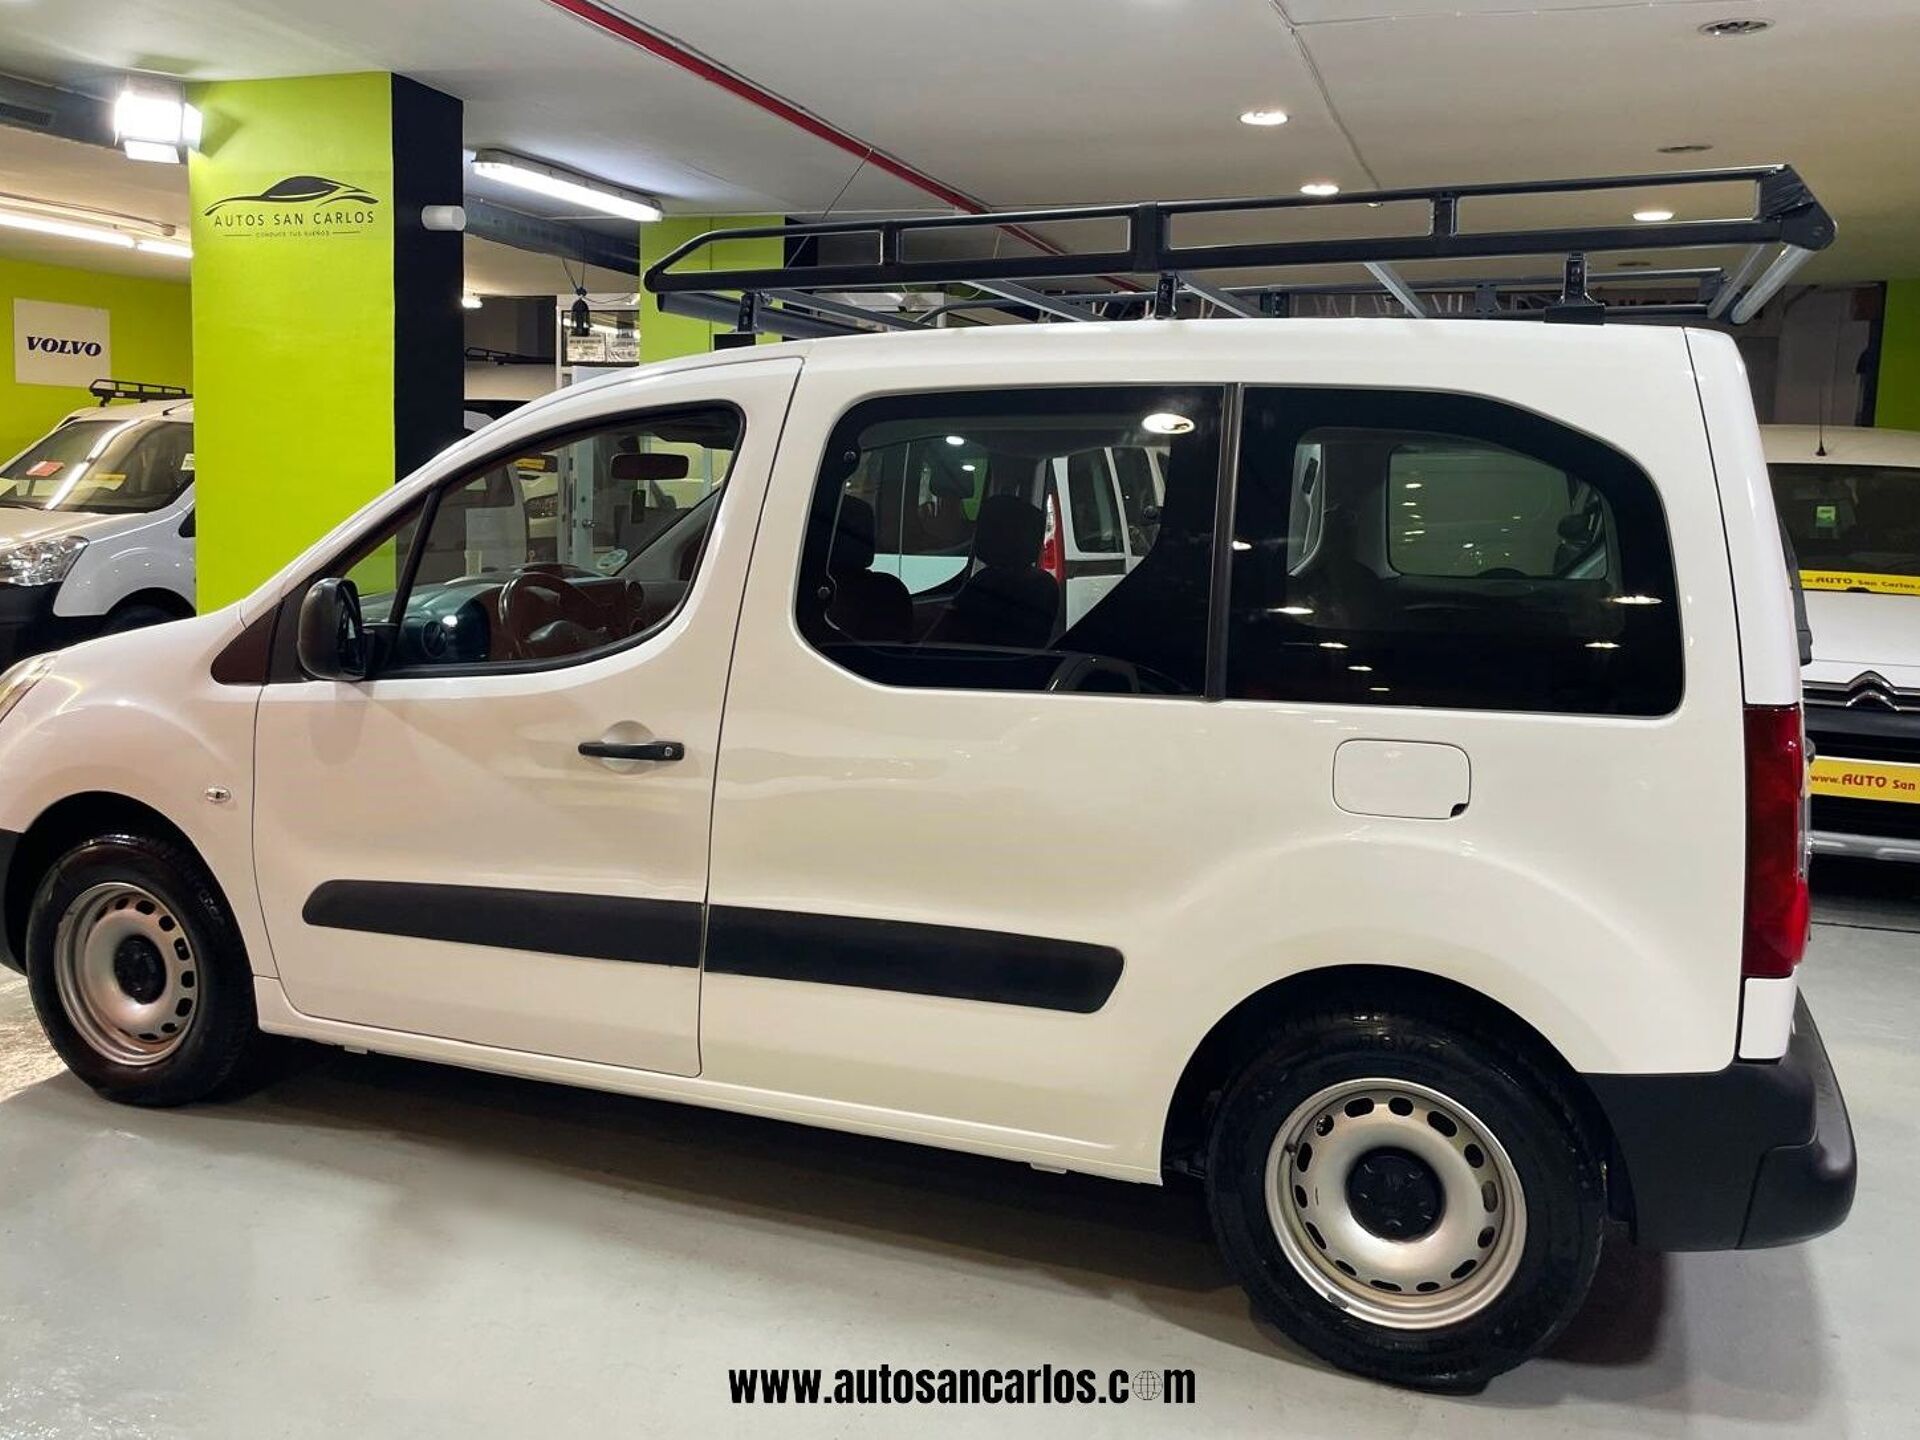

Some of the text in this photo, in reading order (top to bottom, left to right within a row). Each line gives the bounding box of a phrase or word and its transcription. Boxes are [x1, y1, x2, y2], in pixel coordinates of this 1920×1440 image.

[214, 210, 375, 227] AUTOS SAN CARLOS
[26, 336, 102, 357] VOLVO
[1892, 779, 1916, 791] San
